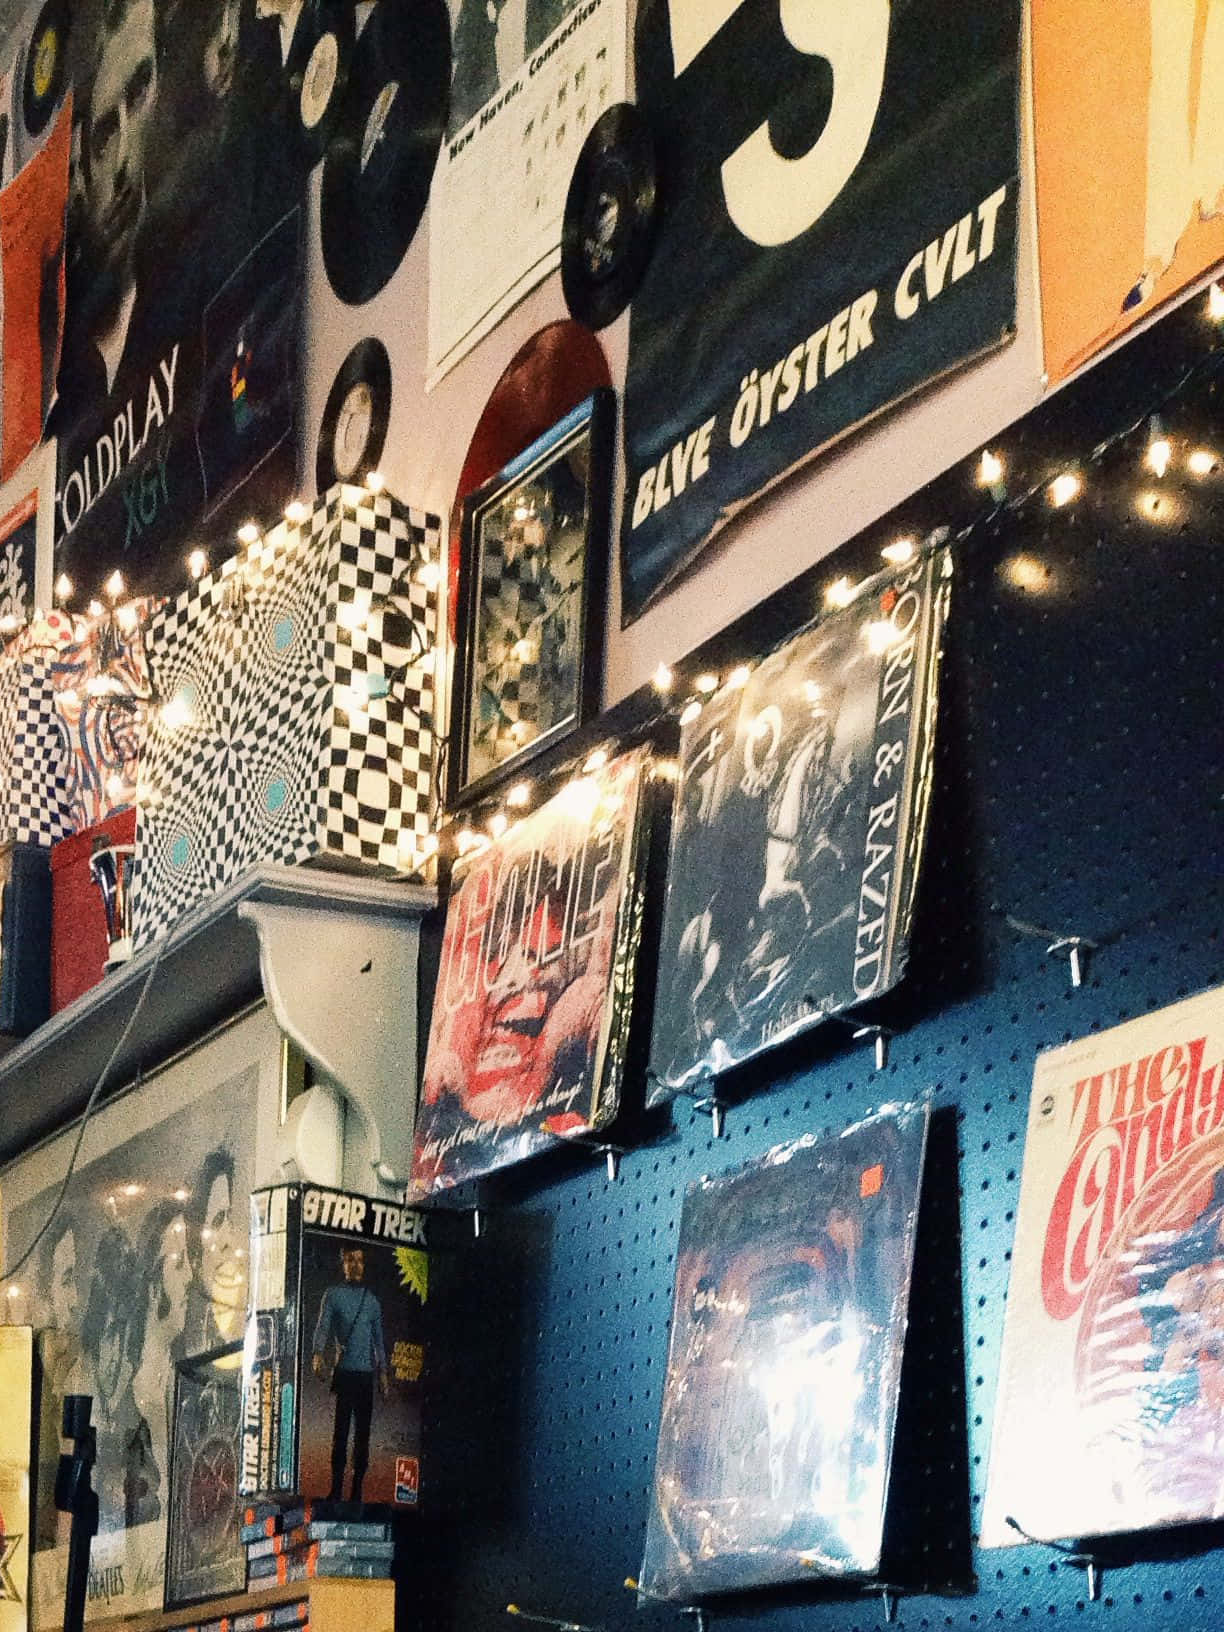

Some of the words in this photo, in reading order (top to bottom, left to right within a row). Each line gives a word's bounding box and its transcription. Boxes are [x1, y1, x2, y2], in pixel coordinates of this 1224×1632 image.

[56, 344, 179, 548] OLDPLAY
[632, 418, 719, 530] BLVE
[729, 290, 878, 447] ÖYSTER
[894, 186, 1007, 320] CVLT
[875, 742, 905, 788] &
[854, 794, 898, 999] RAZED
[304, 1192, 365, 1232] STAR
[372, 1205, 427, 1245] TREK
